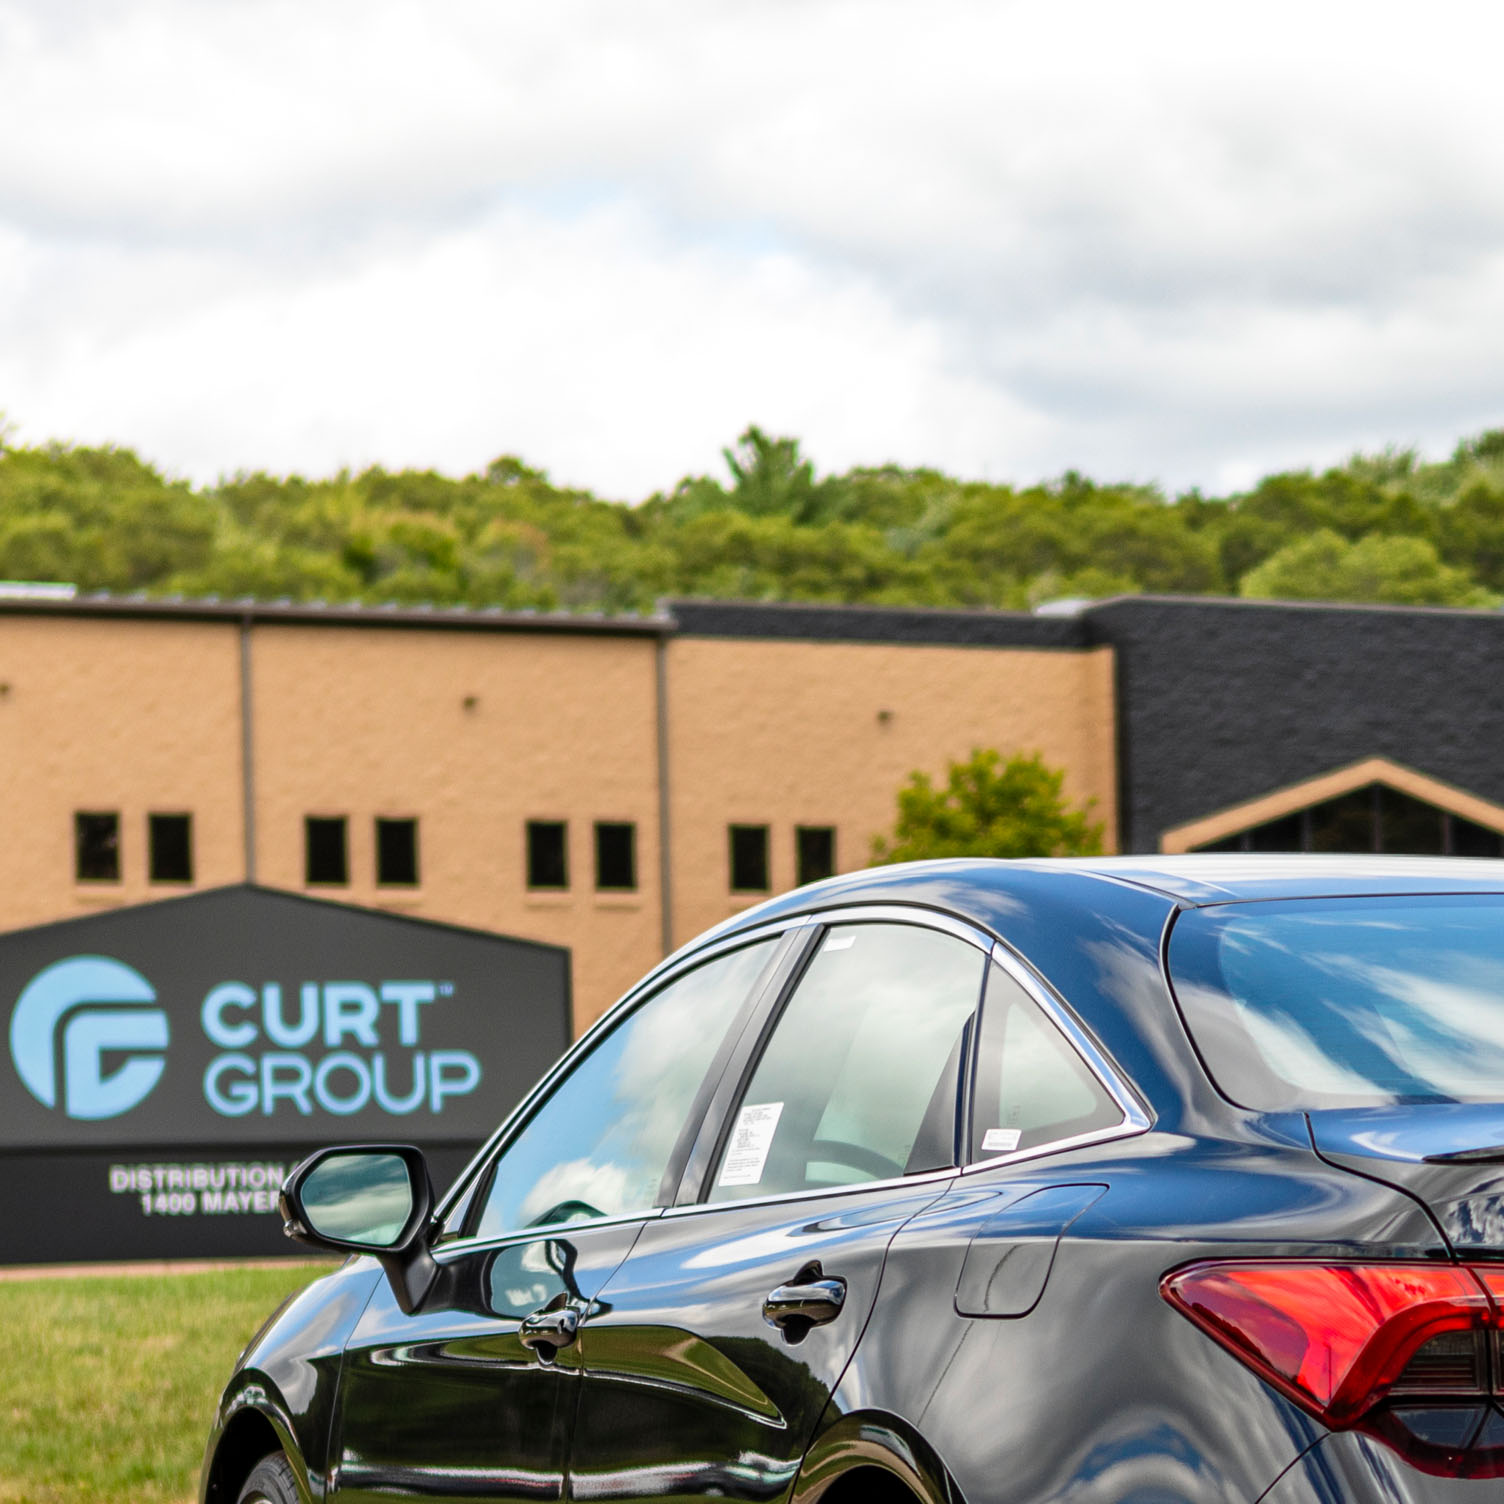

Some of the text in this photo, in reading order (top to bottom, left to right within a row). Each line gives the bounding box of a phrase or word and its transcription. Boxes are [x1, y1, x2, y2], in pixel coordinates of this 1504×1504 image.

[202, 981, 436, 1048] CURT
[202, 1052, 482, 1117] GROUP
[111, 1165, 284, 1191] DISTRIBUTION
[143, 1191, 196, 1214] 1400
